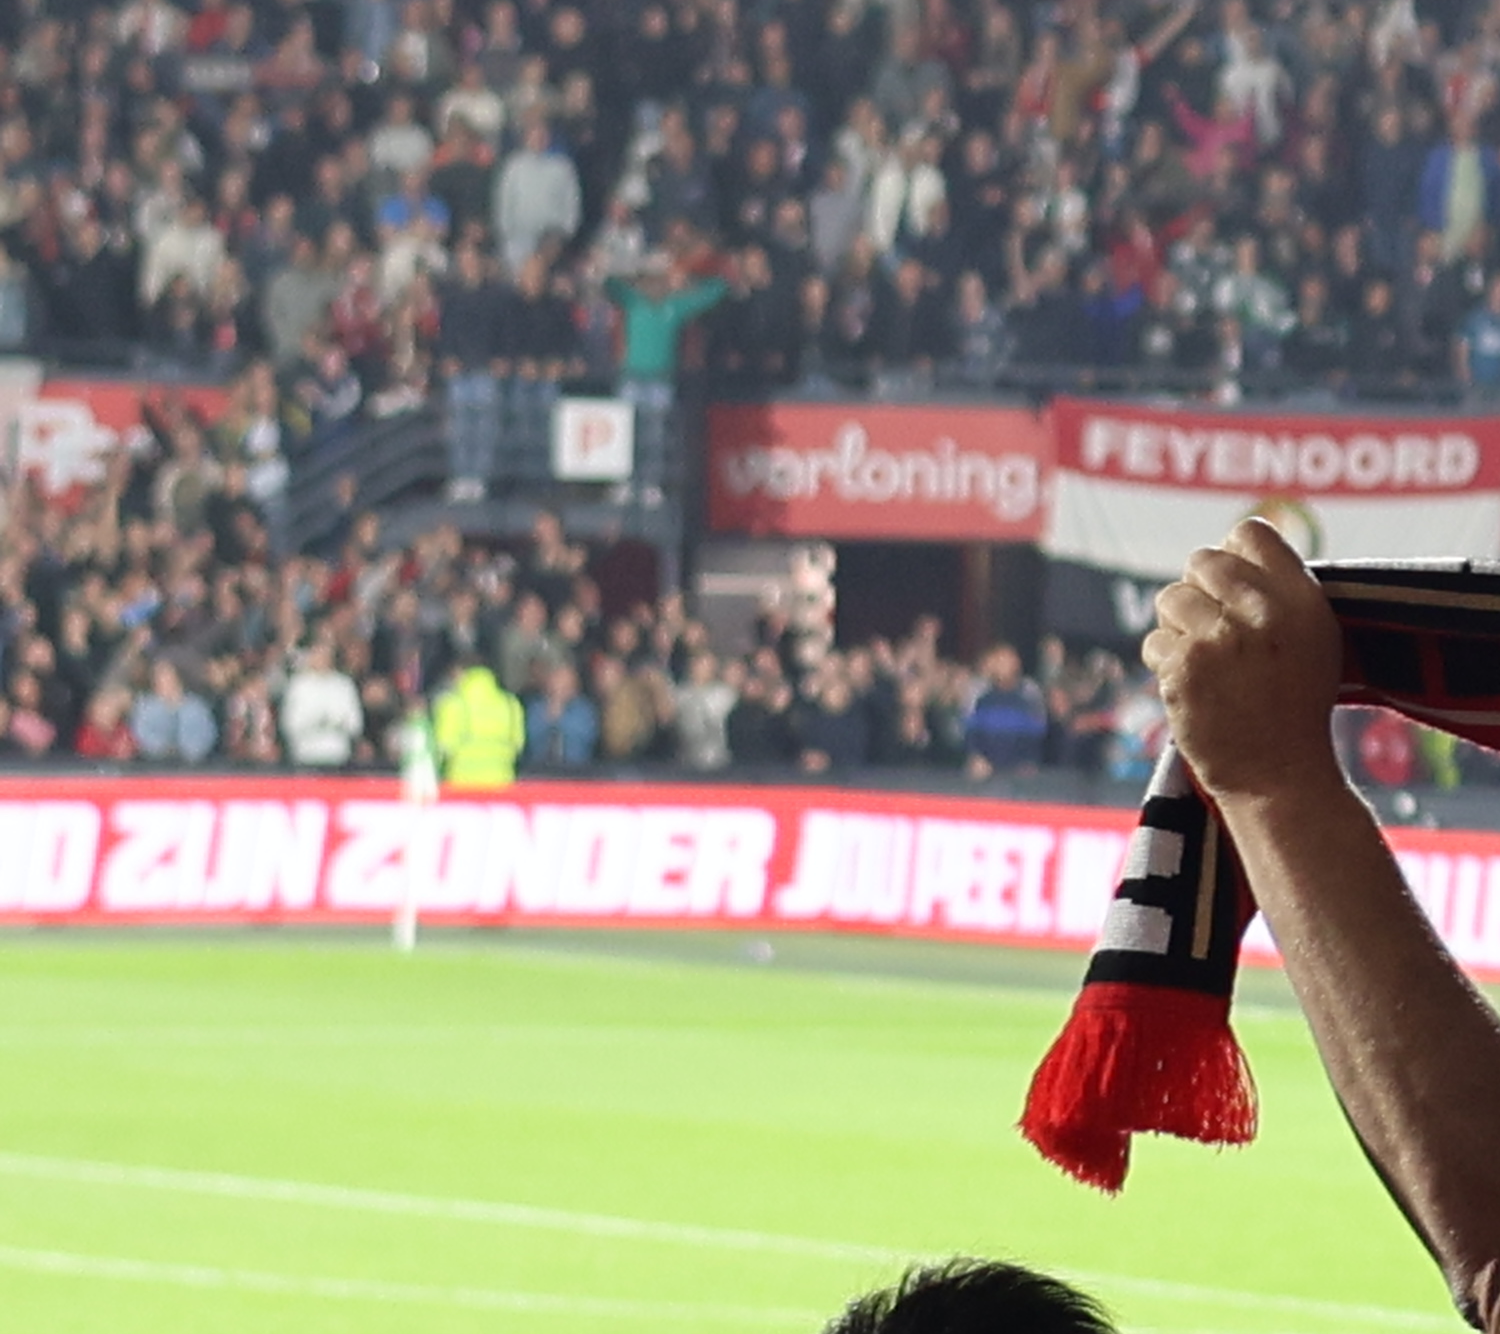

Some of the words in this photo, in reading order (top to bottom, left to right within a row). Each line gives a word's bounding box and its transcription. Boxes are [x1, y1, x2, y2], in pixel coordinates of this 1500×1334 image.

[1082, 414, 1480, 491] FEYENOORD
[103, 800, 328, 912] ZIJN
[327, 801, 778, 918] ZONDER
[773, 810, 915, 922] JOU
